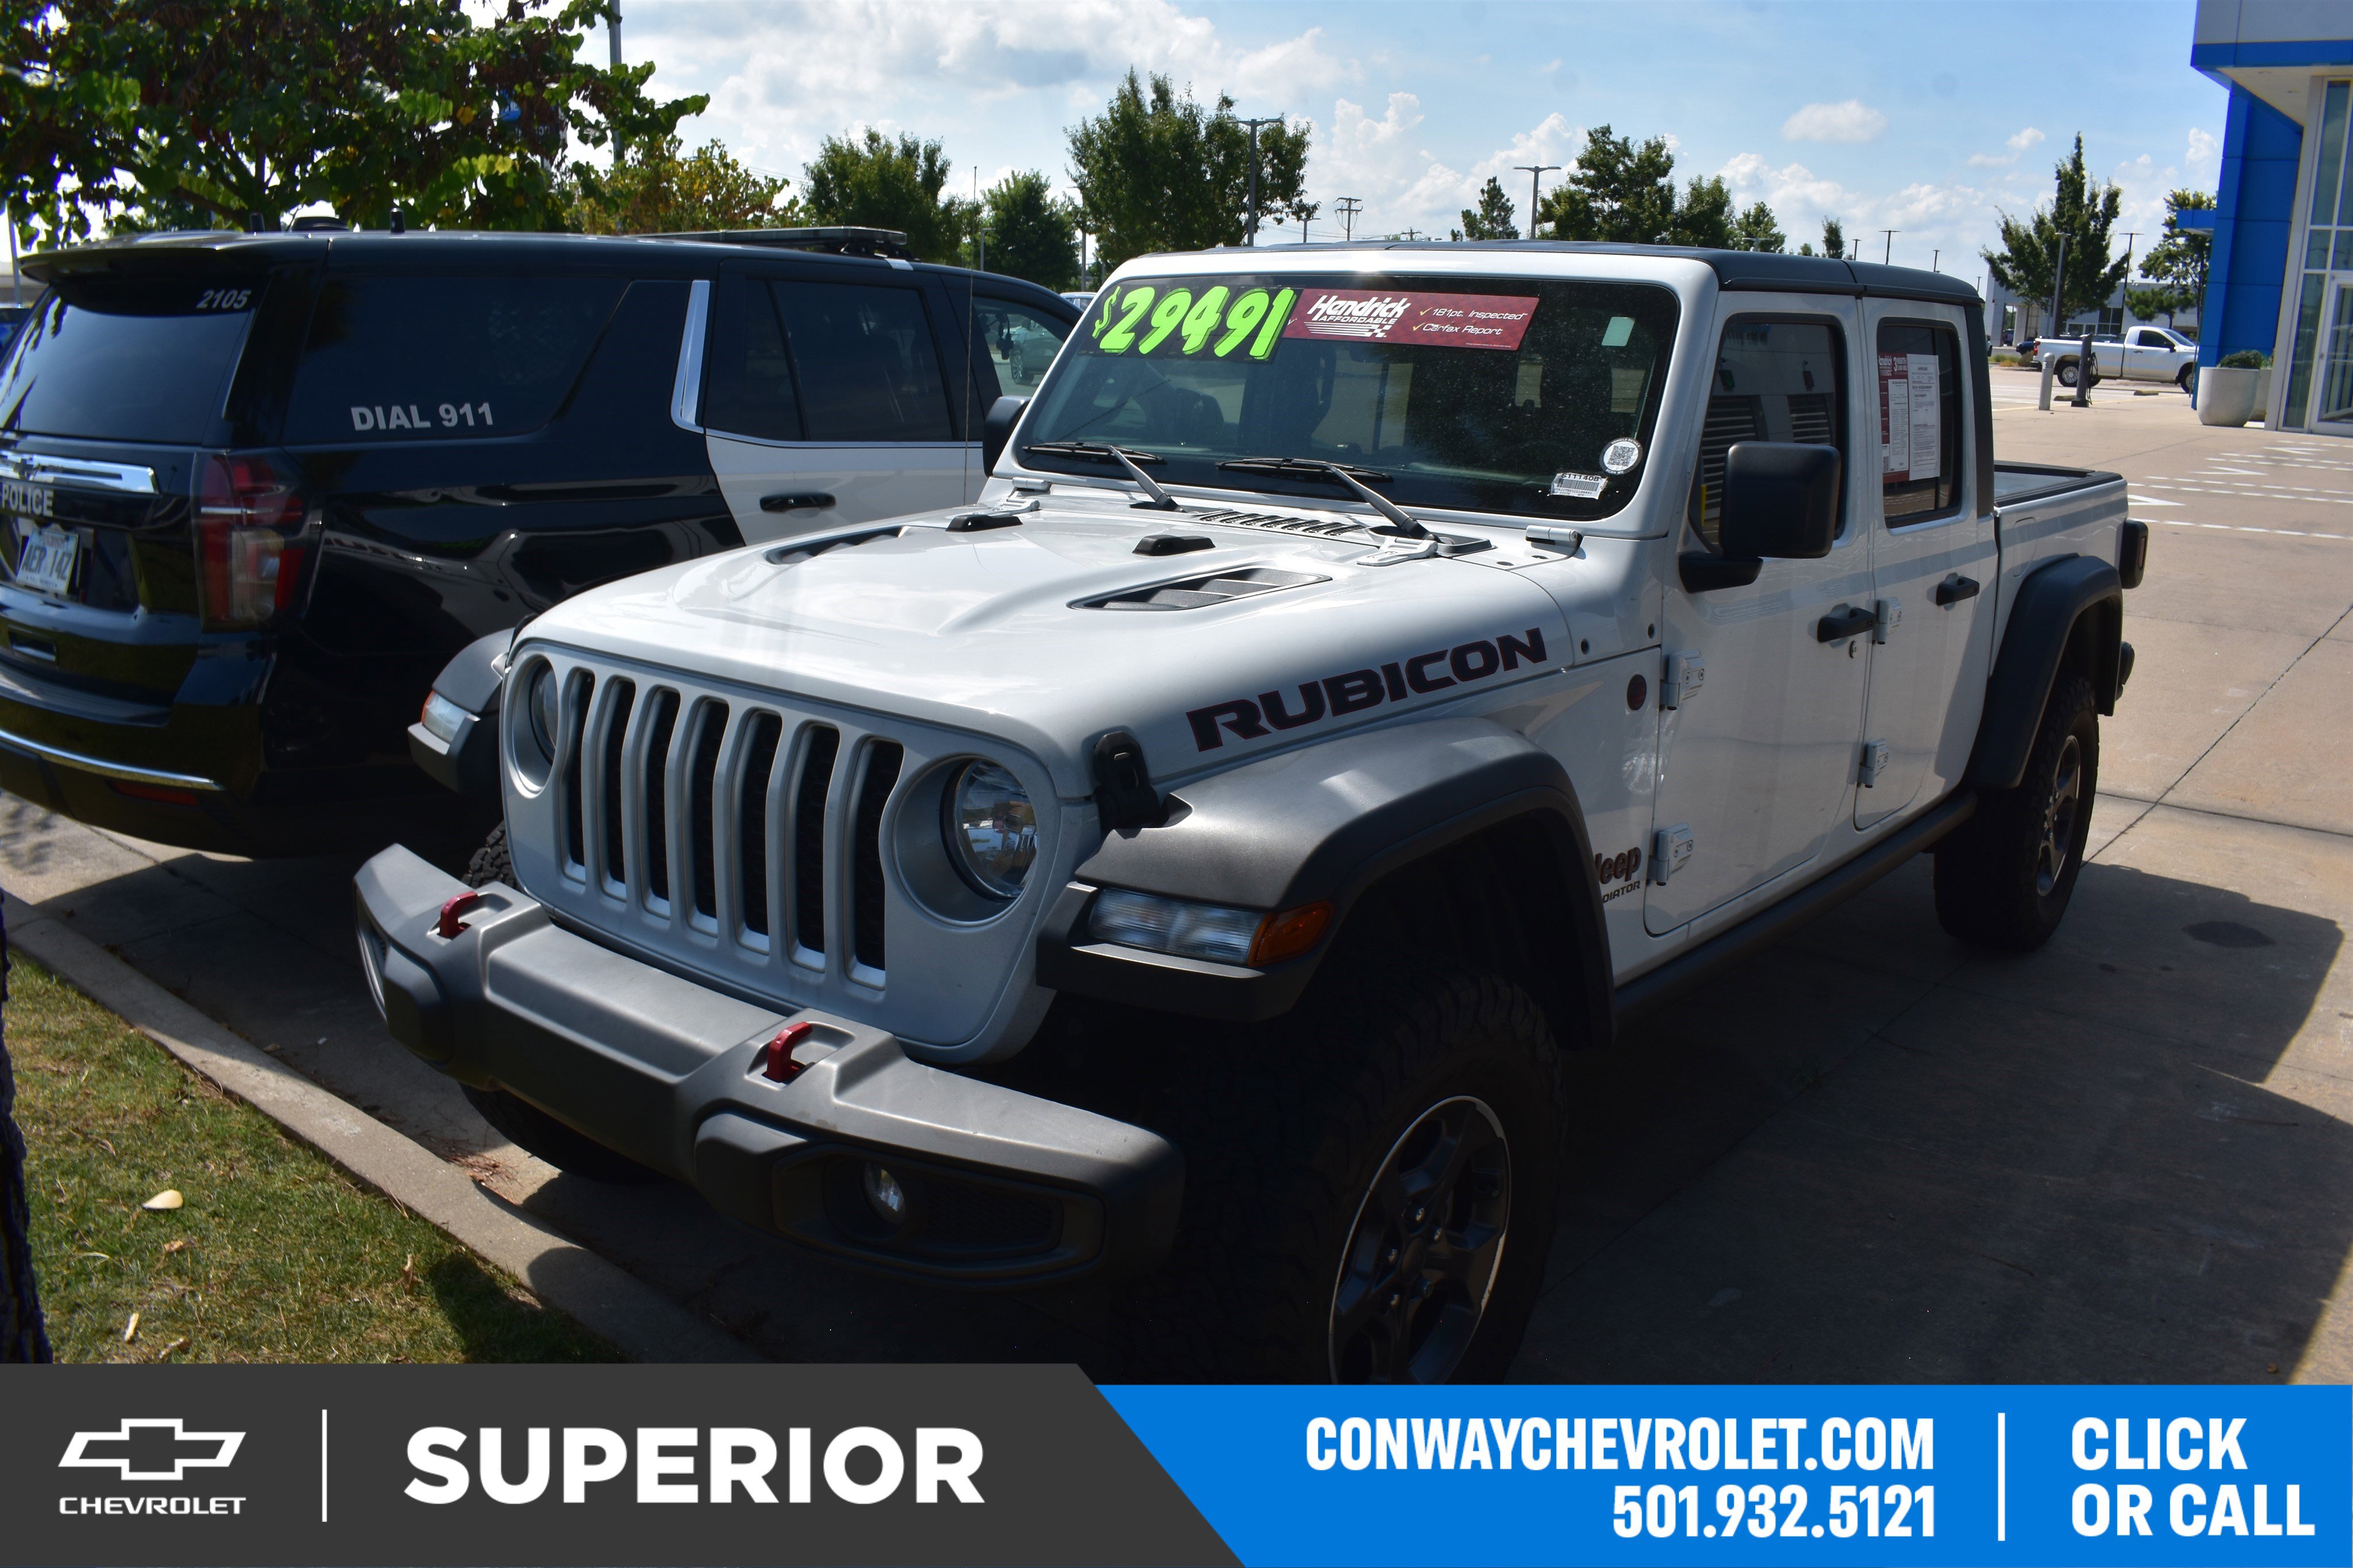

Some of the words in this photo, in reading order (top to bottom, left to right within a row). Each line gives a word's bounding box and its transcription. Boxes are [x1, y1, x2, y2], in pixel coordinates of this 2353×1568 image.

[196, 288, 252, 309] 2105
[1307, 295, 1411, 321] Hendrick
[1092, 285, 1297, 360] $29491
[1320, 316, 1398, 324] AFFORDABLE
[1433, 308, 1464, 317] 181pt.
[1422, 323, 1460, 333] Carfax
[1462, 325, 1503, 335] Report
[350, 404, 431, 431] DIAL
[438, 402, 493, 427] 911
[1561, 473, 1599, 481] S11140B
[1, 483, 54, 516] POLICE
[1186, 627, 1548, 752] RUBICON
[1602, 880, 1641, 903] DIATOR
